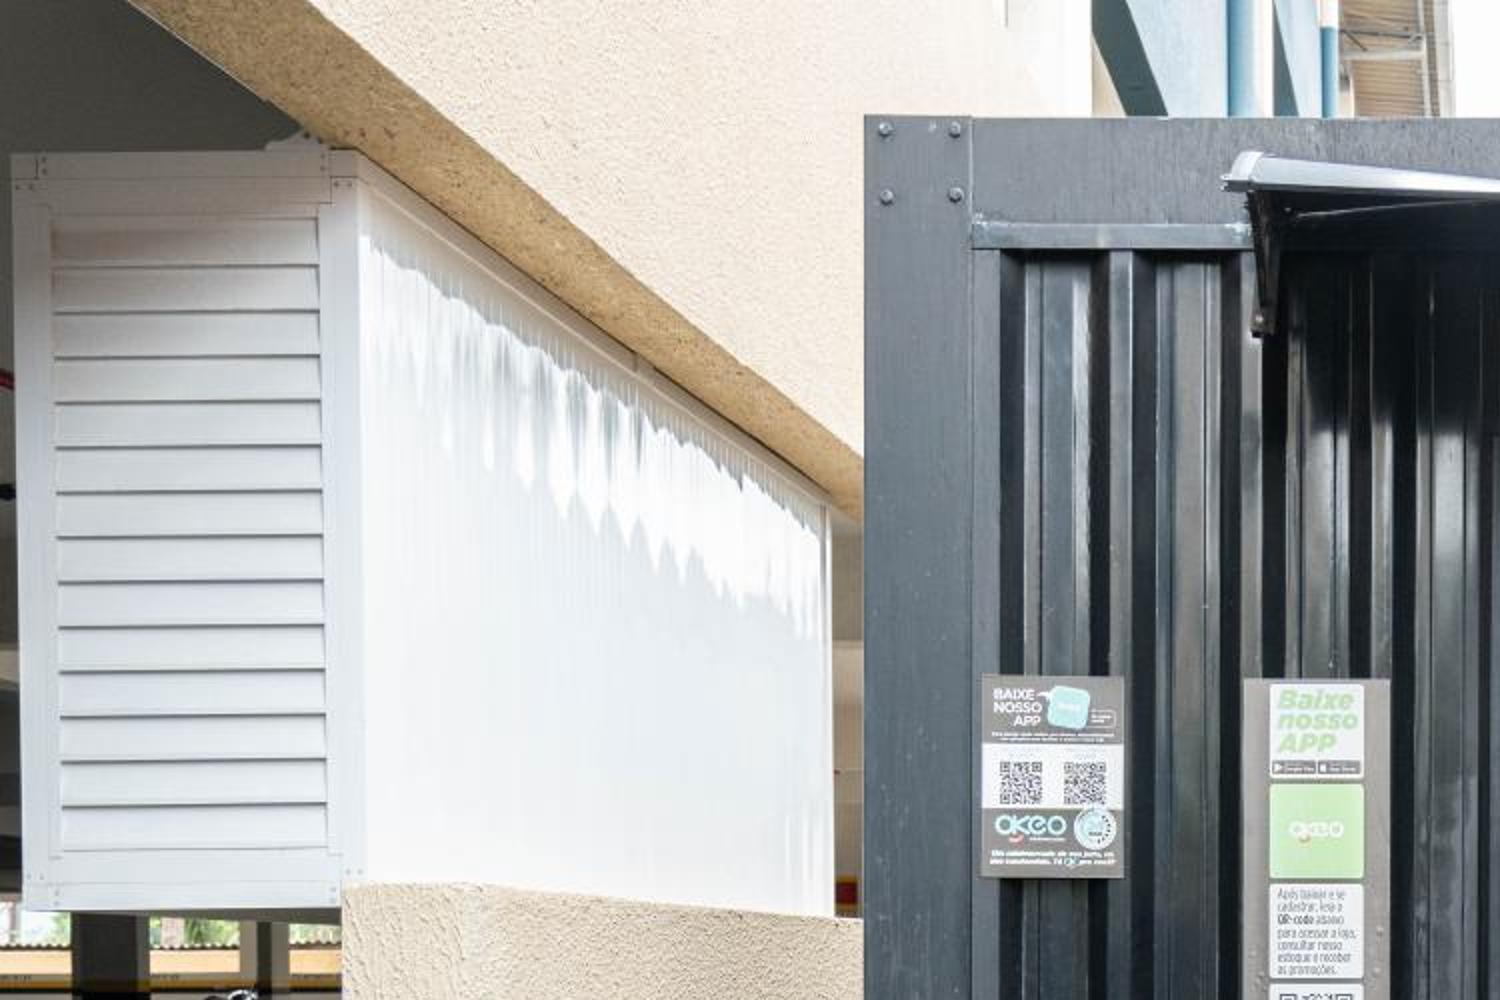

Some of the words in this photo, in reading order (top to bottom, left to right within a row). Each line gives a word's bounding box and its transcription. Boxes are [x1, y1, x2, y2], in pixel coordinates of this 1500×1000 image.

[993, 687, 1035, 700] BAIXE
[1279, 688, 1354, 709] Baixe
[993, 701, 1043, 713] NOSSO
[1013, 715, 1041, 726] APP
[1278, 713, 1358, 730] nosso
[1279, 733, 1337, 753] APP
